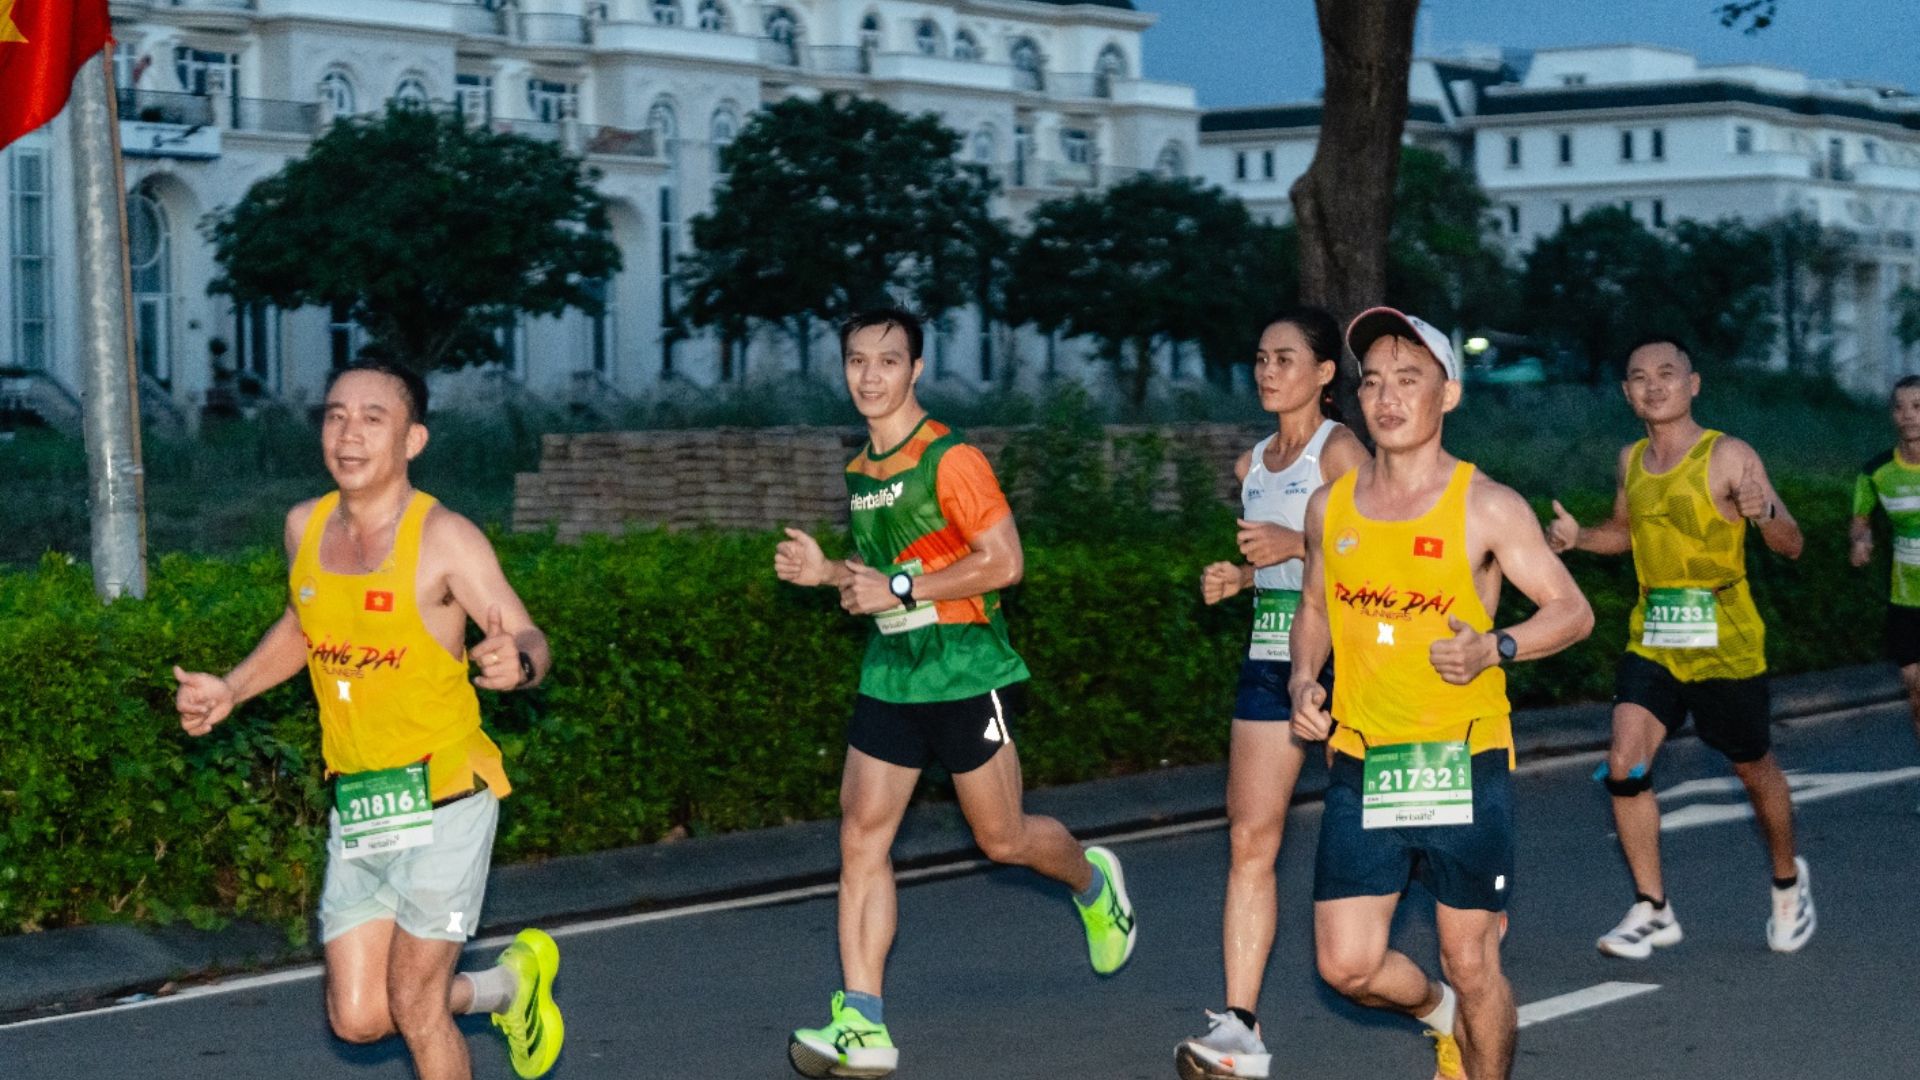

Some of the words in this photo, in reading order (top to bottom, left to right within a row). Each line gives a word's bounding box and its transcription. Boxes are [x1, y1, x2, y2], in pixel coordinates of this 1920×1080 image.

[850, 486, 895, 511] Herbalife
[1651, 605, 1703, 621] 21733
[1379, 767, 1452, 791] 21732
[350, 789, 414, 820] 21816
